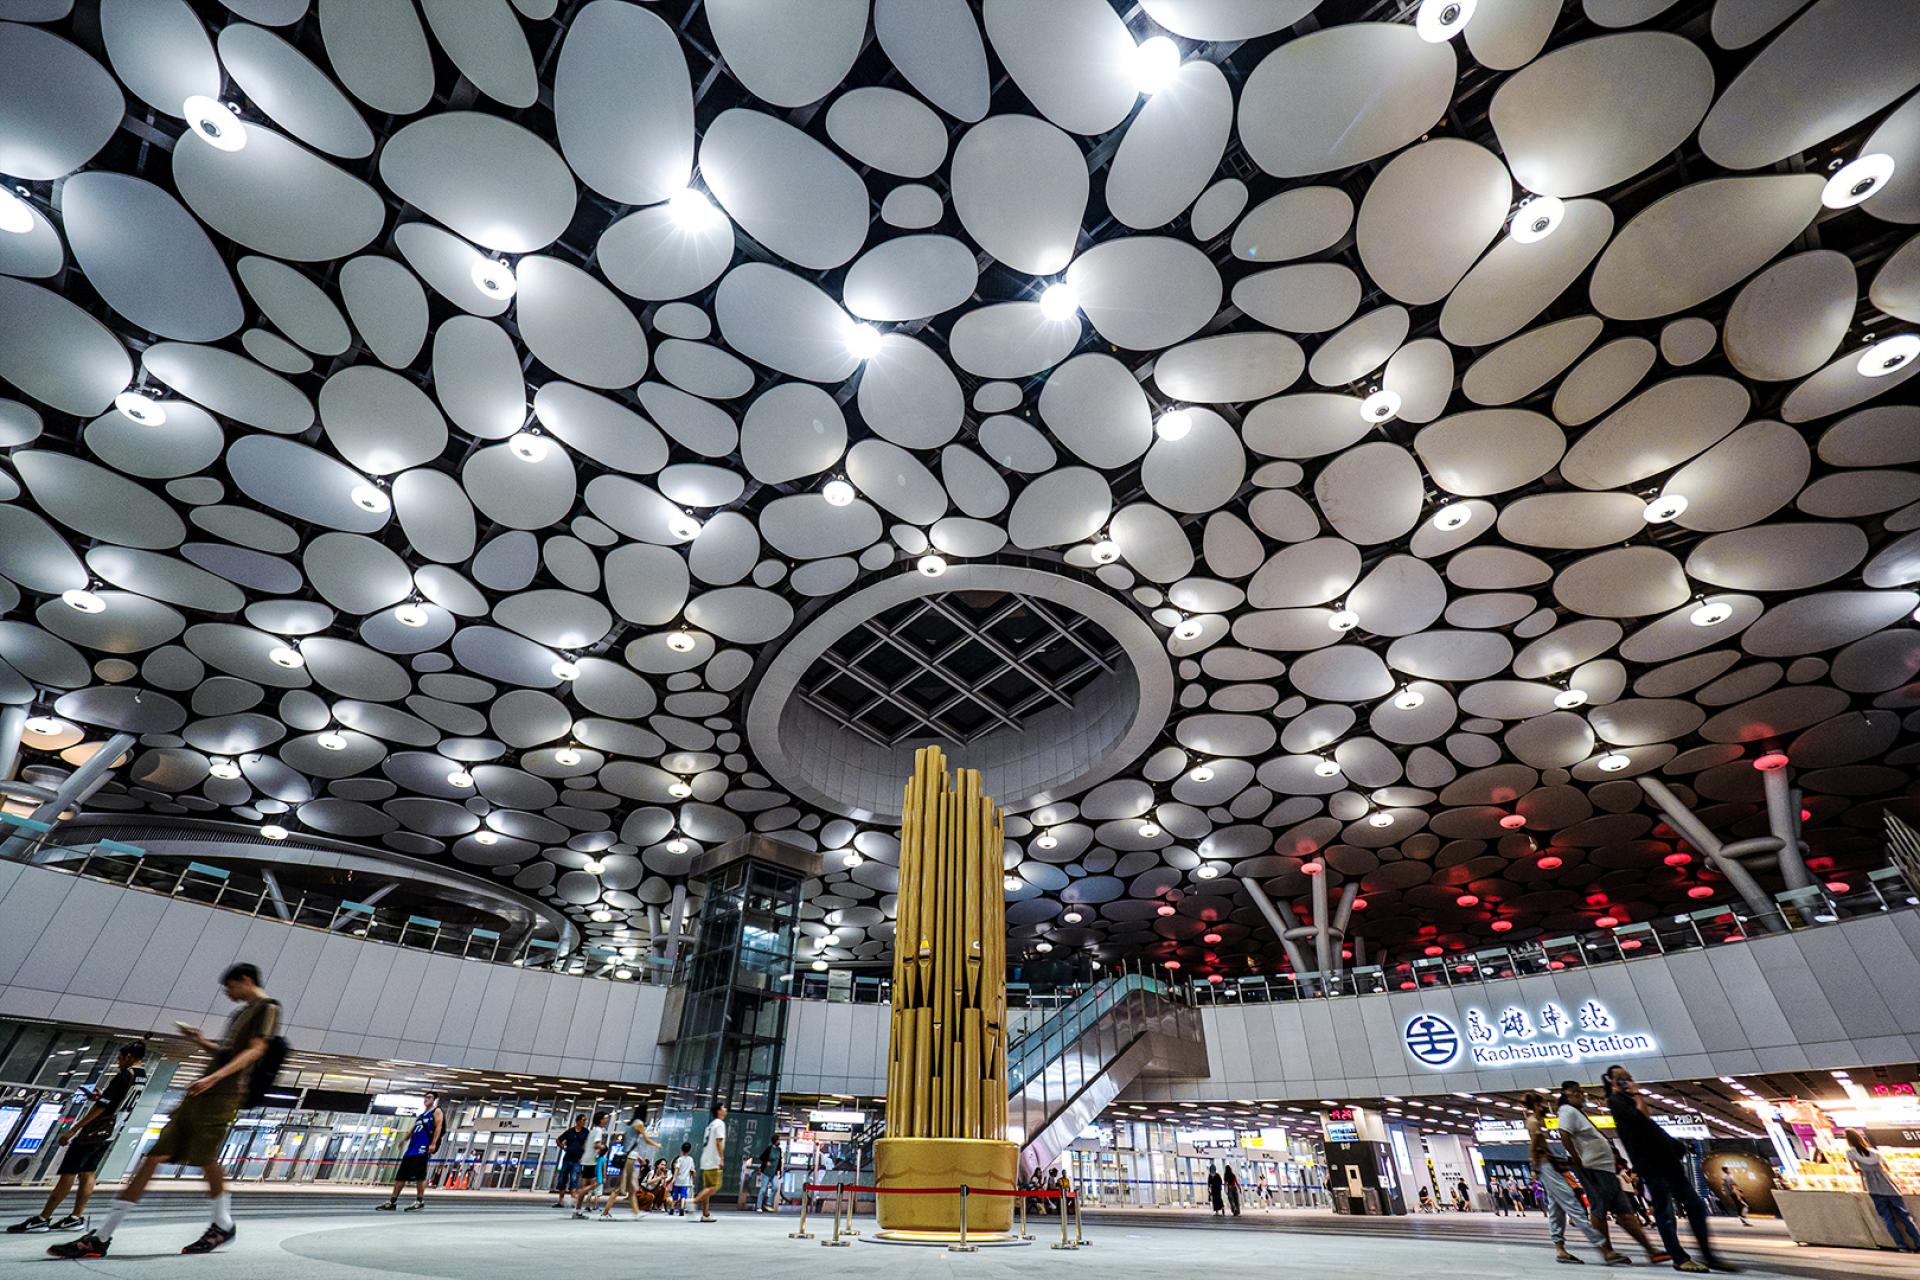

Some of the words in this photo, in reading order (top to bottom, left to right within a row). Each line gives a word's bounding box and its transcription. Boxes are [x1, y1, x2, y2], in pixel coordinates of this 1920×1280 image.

[1467, 1001, 1609, 1042] 高雄車站
[1473, 1042, 1573, 1063] Kaohsiung
[1576, 1034, 1649, 1054] Station
